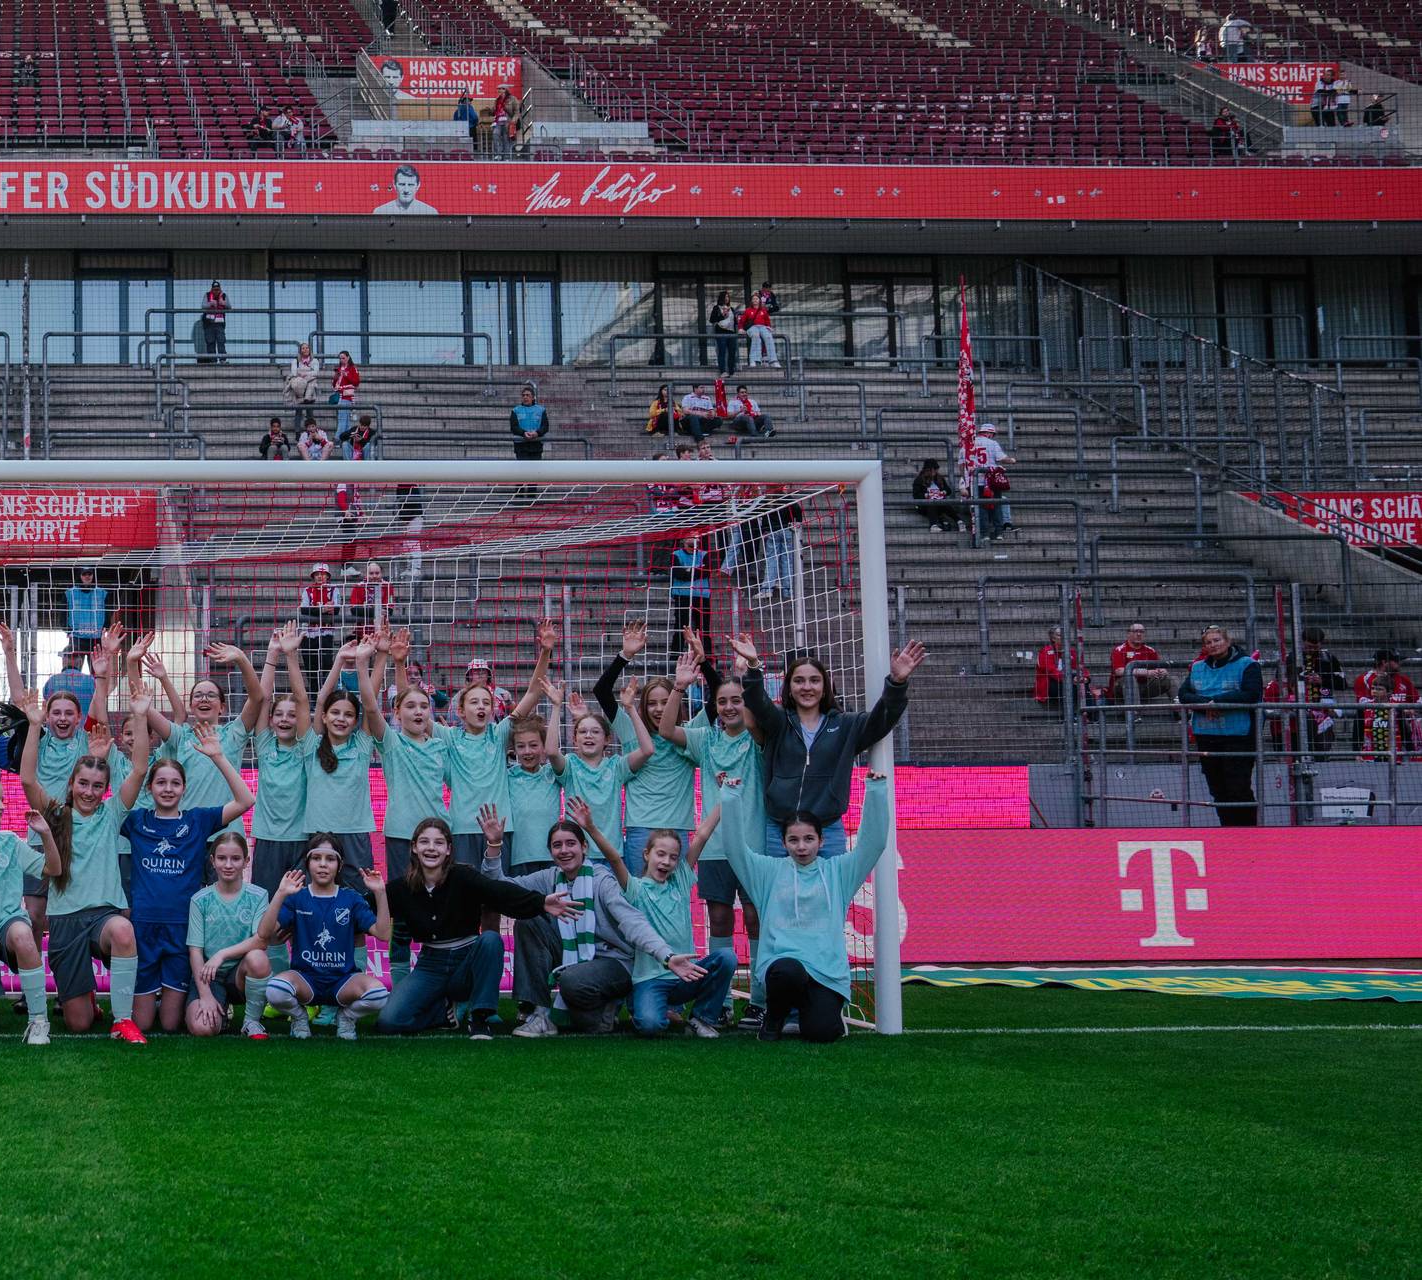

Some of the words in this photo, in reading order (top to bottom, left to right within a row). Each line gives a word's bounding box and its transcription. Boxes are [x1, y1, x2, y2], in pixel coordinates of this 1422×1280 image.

[409, 60, 446, 76] HANS
[451, 58, 516, 76] SCHÄFER
[1228, 67, 1266, 81] HANS
[1269, 64, 1334, 82] SCHÄFE
[409, 77, 484, 96] SÜDKURVE
[85, 164, 286, 210] SÜDKURVE
[34, 492, 126, 518] SCHÄFER
[1314, 498, 1366, 519] HANS
[141, 857, 186, 870] QUIRIN
[1117, 840, 1209, 947] T
[301, 949, 346, 963] QUIRIN
[311, 961, 346, 969] PRIVATBANK
